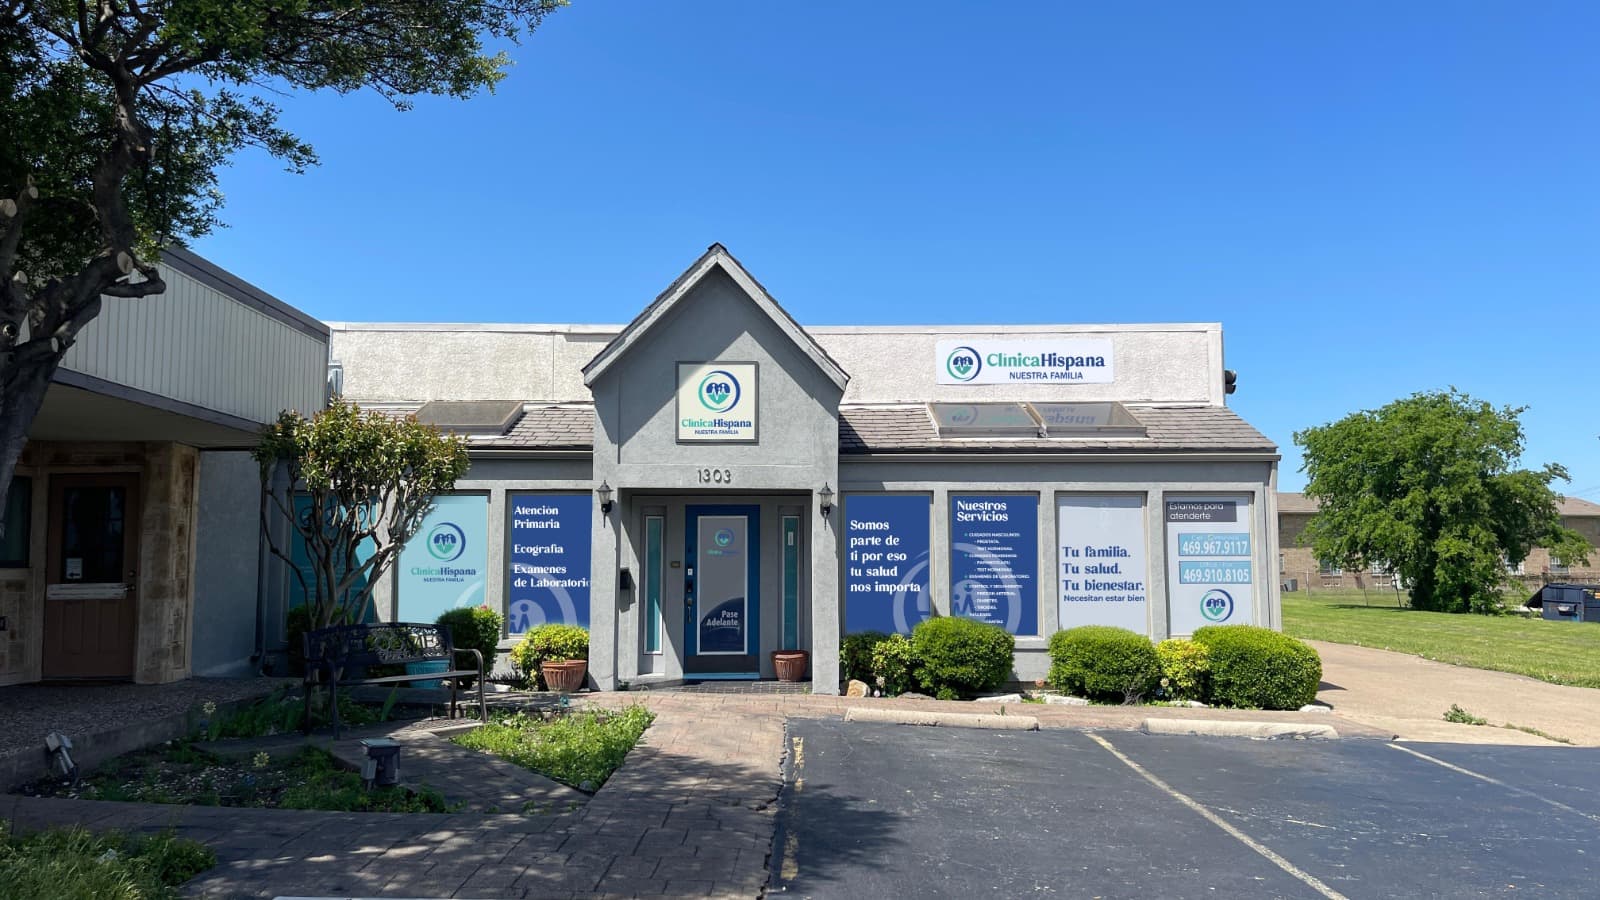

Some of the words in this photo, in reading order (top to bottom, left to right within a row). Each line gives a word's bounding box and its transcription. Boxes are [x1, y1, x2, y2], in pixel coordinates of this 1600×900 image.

[1009, 371, 1048, 380] NUESTRA
[1050, 371, 1083, 380] FAMILIA
[697, 469, 732, 484] 1303
[957, 500, 1007, 511] Nuestros
[1203, 503, 1224, 511] para
[956, 511, 1009, 521] Servicios
[1169, 512, 1211, 520] atenderte
[514, 518, 560, 529] Primaria
[850, 519, 890, 530] Somos
[850, 536, 882, 548] parte
[885, 535, 900, 546] de
[1062, 546, 1080, 557] Tu
[1084, 546, 1131, 558] familia.
[1182, 541, 1248, 554] 469.967.9117
[850, 551, 858, 561] ti
[861, 553, 883, 564] por
[886, 553, 907, 561] eso
[850, 567, 862, 577] tu
[865, 566, 898, 577] salud
[1062, 563, 1080, 574] Tu
[1084, 562, 1122, 574] salud.
[1183, 569, 1249, 582] 469.910.8105
[514, 577, 527, 587] de
[1062, 580, 1080, 590] Tu
[1084, 579, 1145, 591] bienestar.
[850, 584, 871, 592] nos
[874, 581, 921, 595] importa
[721, 610, 739, 618] Pase
[706, 617, 739, 626] Adelante
